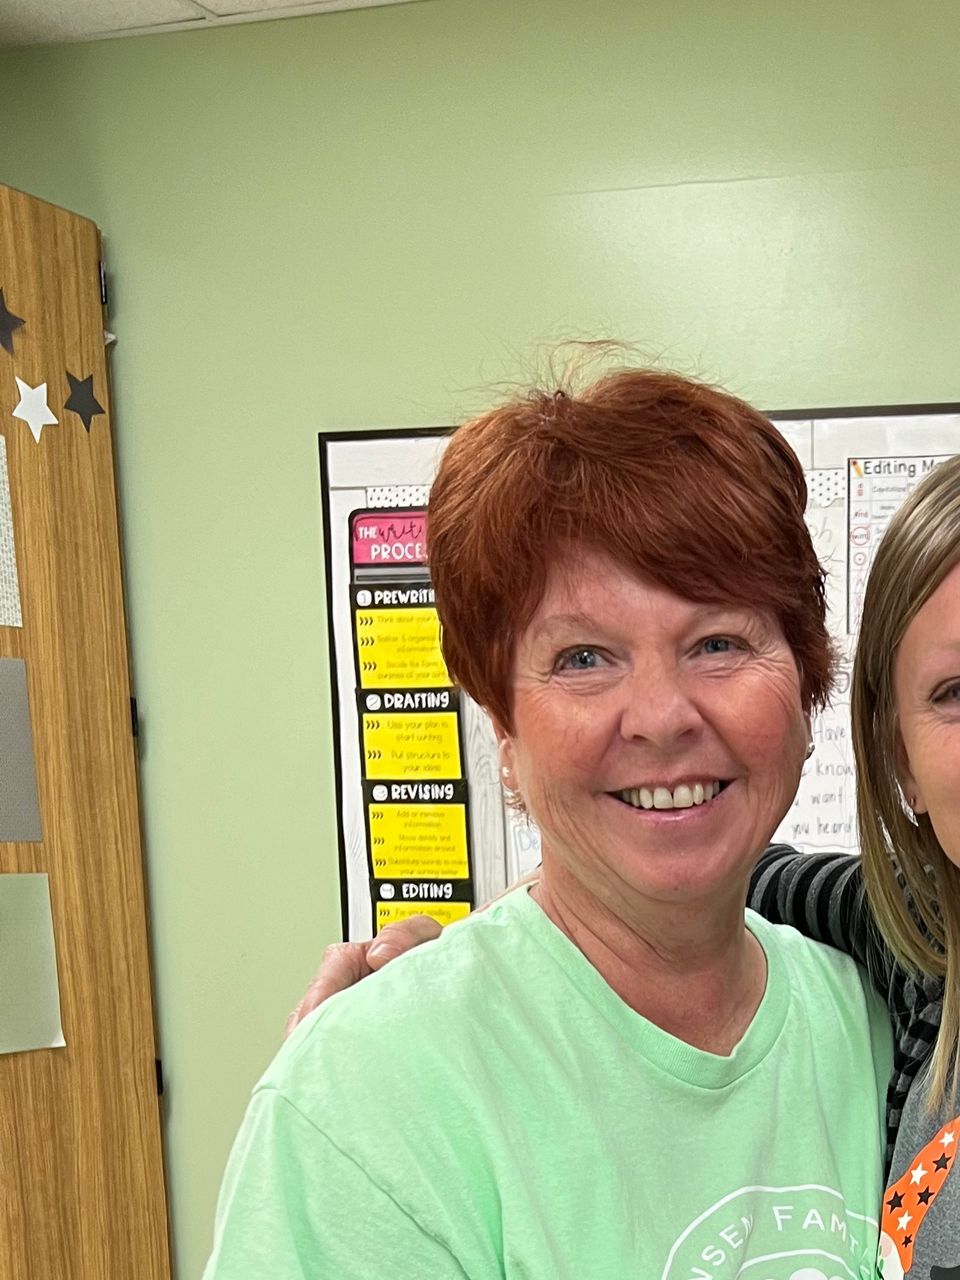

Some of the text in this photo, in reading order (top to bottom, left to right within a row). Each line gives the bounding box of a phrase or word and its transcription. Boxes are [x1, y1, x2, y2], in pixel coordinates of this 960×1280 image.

[864, 460, 916, 477] Editing
[358, 526, 377, 539] THE
[811, 787, 844, 804] want
